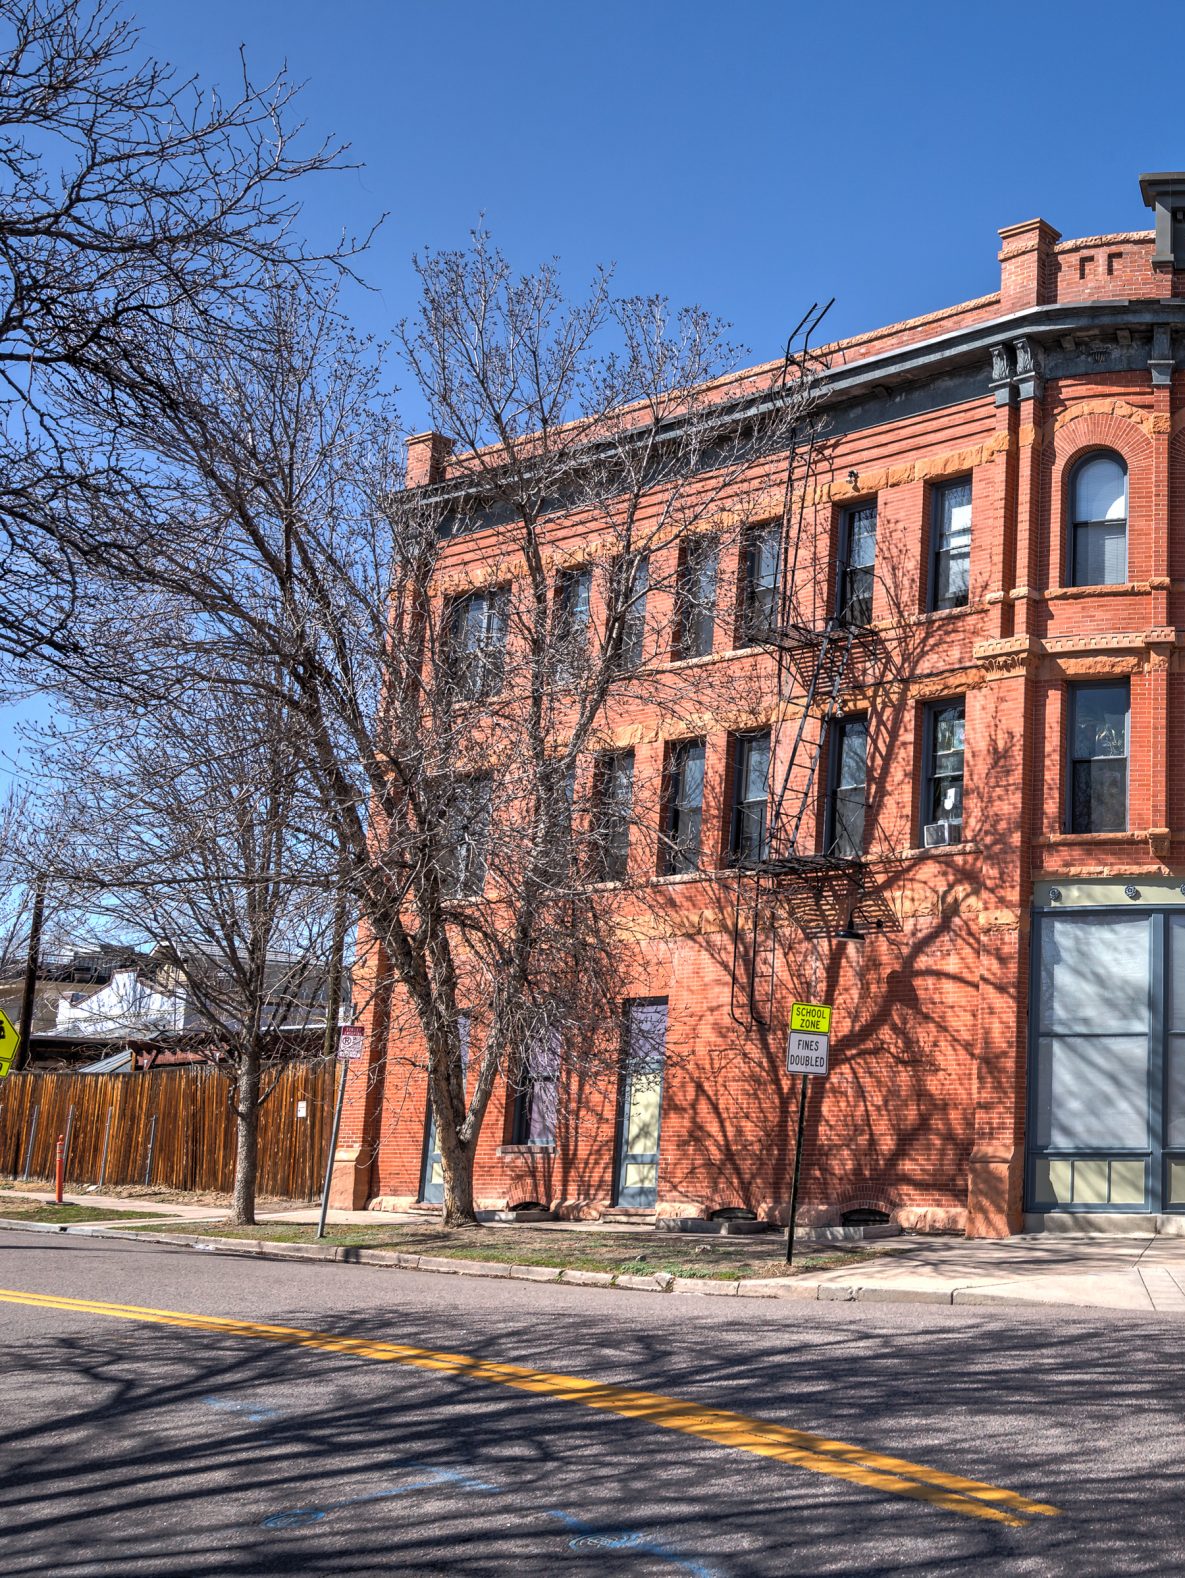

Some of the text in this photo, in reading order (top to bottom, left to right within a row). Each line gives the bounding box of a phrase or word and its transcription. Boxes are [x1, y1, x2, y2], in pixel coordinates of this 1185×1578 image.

[796, 1006, 826, 1019] SCHOOL
[800, 1018, 821, 1029] ZONE
[797, 1039, 820, 1051] FINES
[790, 1054, 825, 1067] DOUBLED
